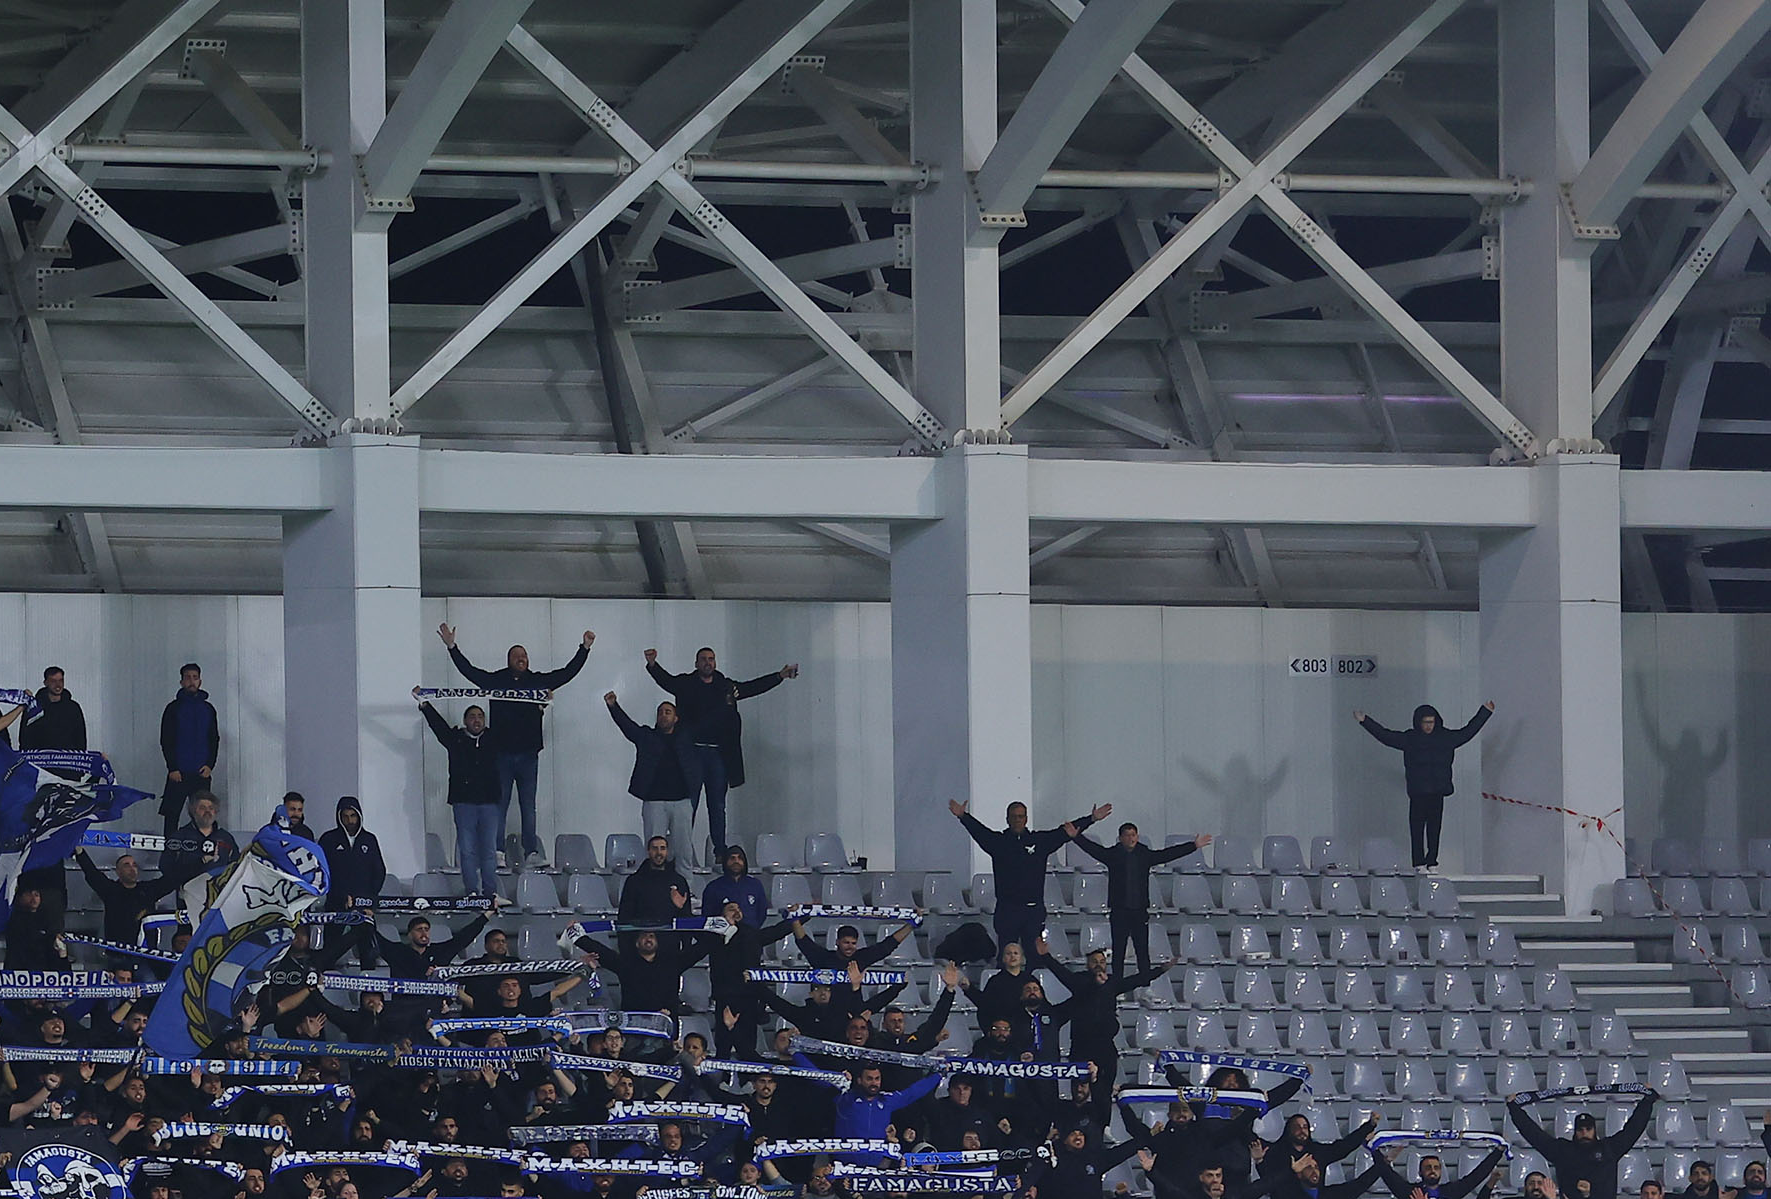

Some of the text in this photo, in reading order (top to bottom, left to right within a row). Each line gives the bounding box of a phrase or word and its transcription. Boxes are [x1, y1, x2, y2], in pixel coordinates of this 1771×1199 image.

[1302, 659, 1327, 673] 803
[1338, 660, 1363, 674] 802
[749, 969, 906, 985] MAXHTEC SAONICA
[255, 1037, 390, 1059] Freedom to Famagusta
[951, 1061, 1080, 1080] FAMAGUSTA
[234, 1123, 293, 1147] UNIO
[26, 1145, 94, 1168] FAMAGUSTA
[852, 1176, 1017, 1192] FAMAGUSTA
